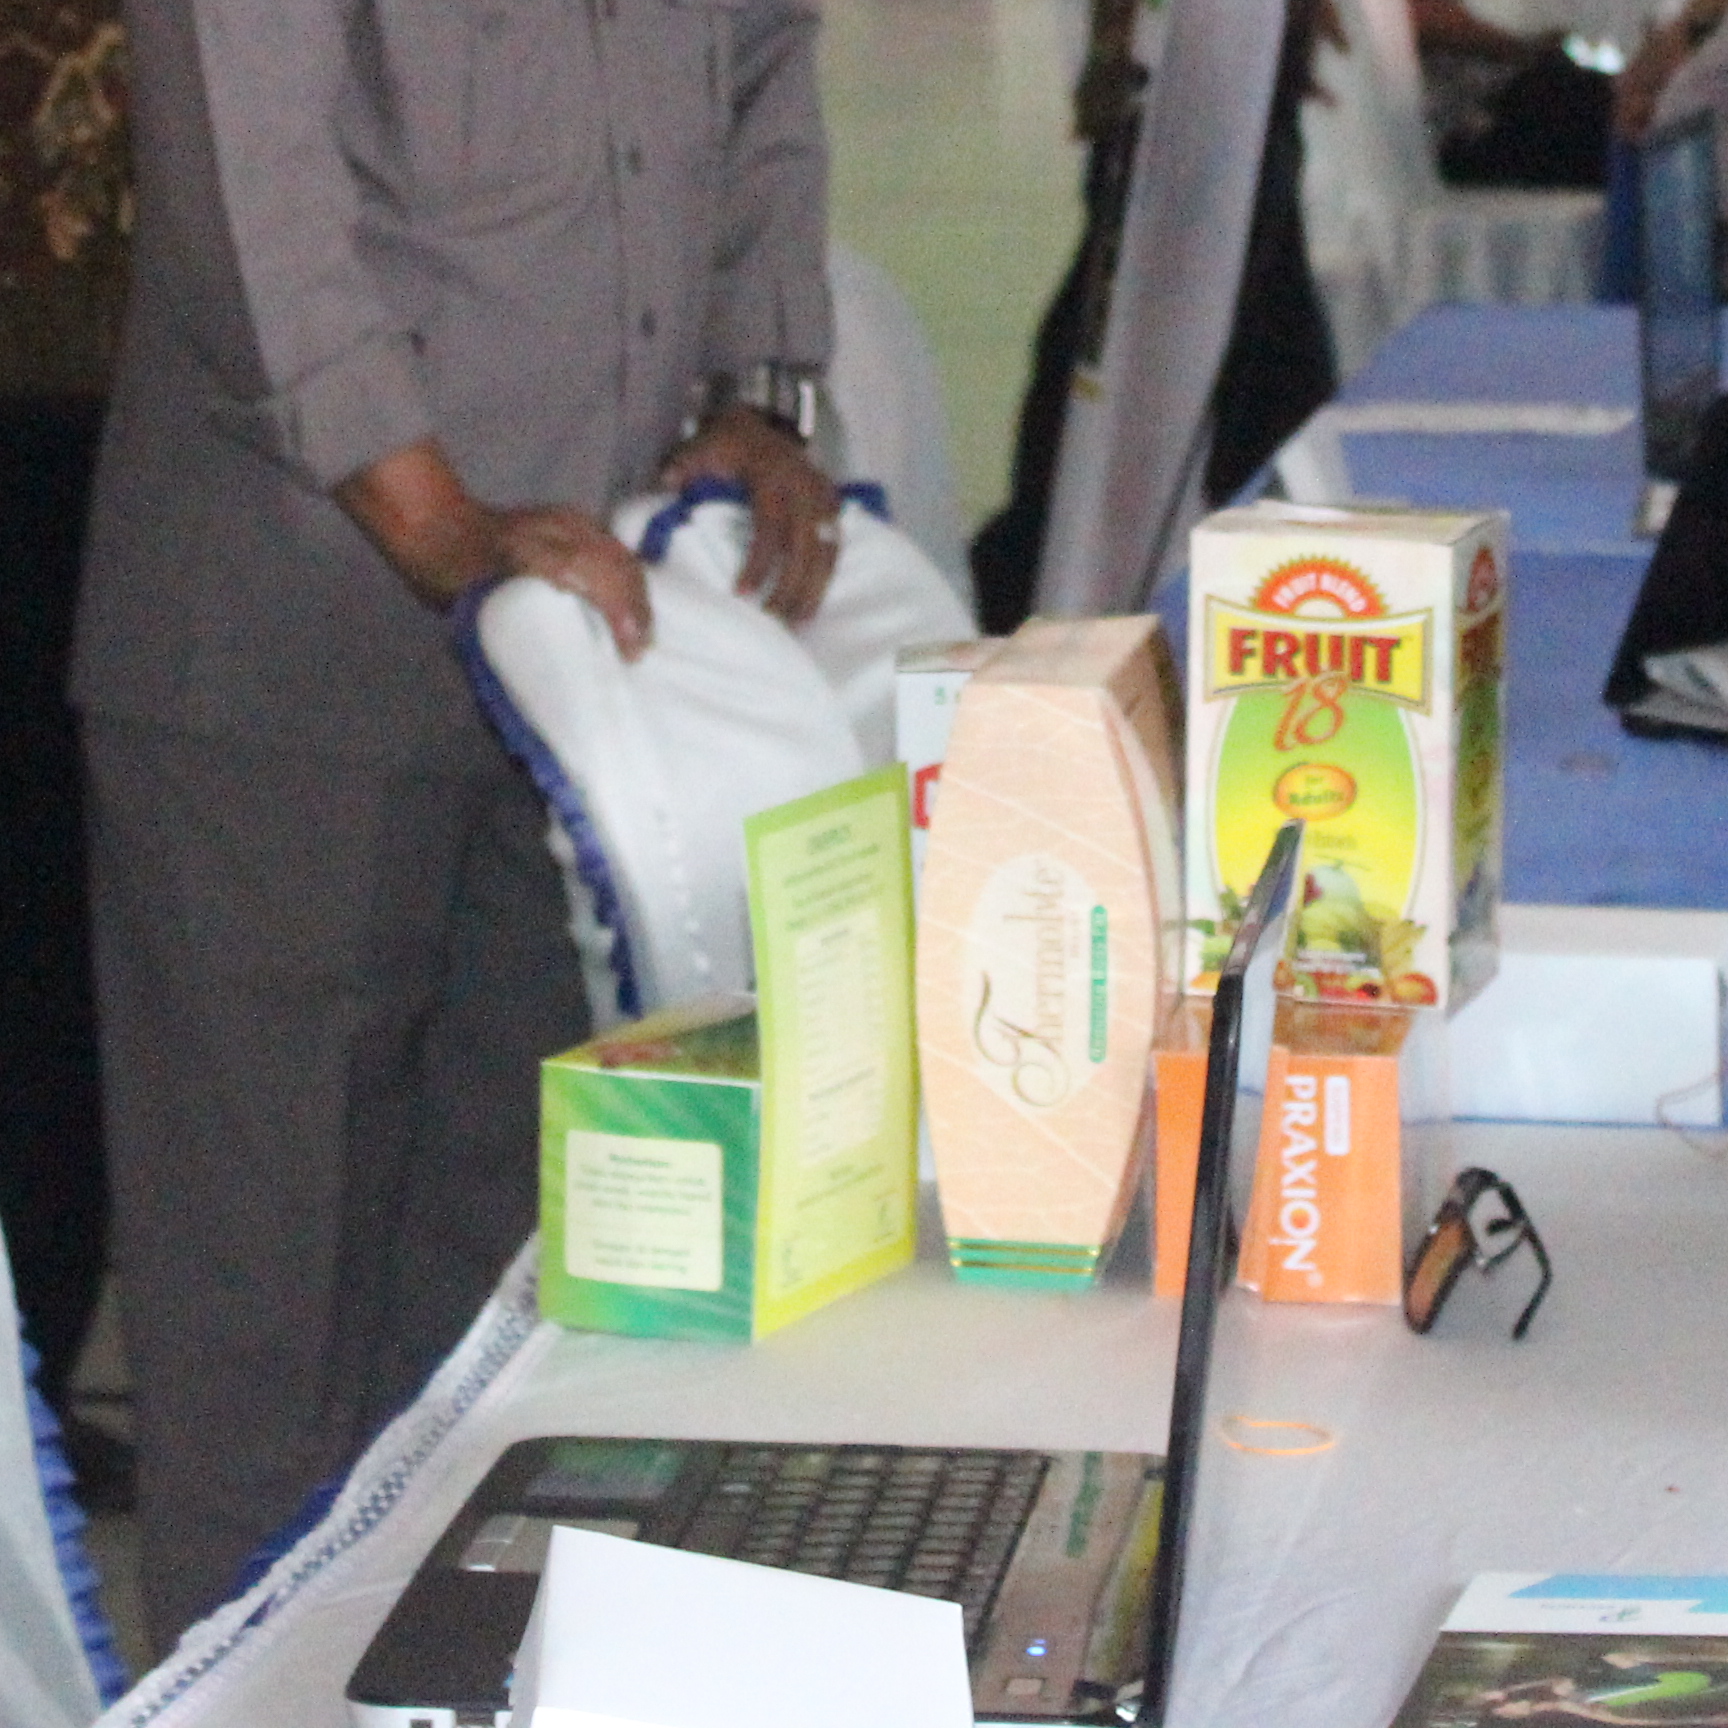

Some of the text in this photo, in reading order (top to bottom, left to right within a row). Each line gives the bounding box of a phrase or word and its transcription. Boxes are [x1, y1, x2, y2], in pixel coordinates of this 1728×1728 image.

[1272, 571, 1318, 609] FRUIT
[1227, 626, 1402, 684] FRUIT
[1274, 670, 1349, 752] 18
[972, 864, 1071, 1108] Thermolyte
[1268, 1074, 1320, 1272] PRAXION
